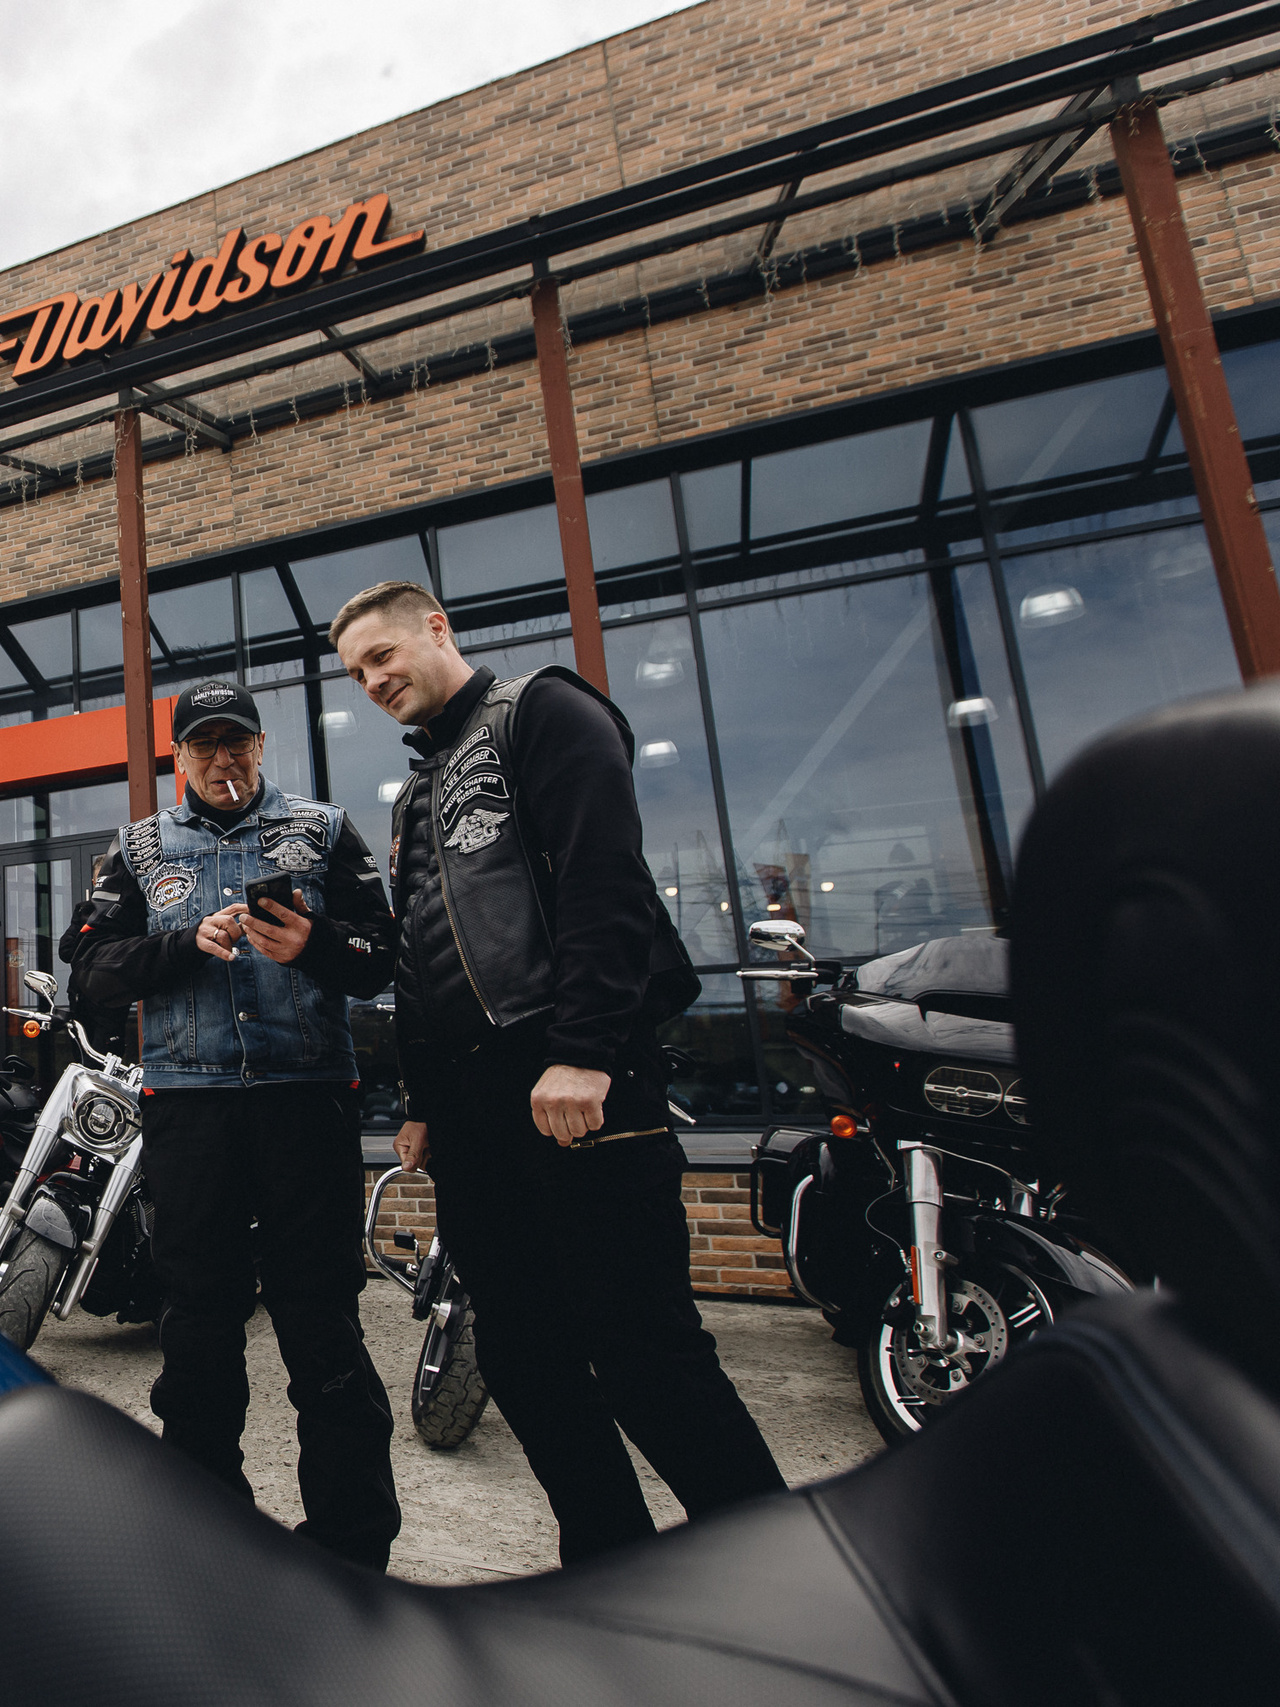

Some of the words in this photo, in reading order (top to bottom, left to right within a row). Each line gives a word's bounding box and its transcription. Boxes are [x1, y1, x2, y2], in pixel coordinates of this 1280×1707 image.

[444, 773, 460, 791] LIFE
[460, 750, 490, 773] MEMBER
[444, 787, 465, 814] BAIKAL
[464, 776, 499, 789] CHAPTER
[456, 784, 482, 804] RUSSIA
[265, 825, 289, 837] BAIKAL
[289, 823, 322, 833] CHAPTER
[280, 827, 306, 835] RUSSIA
